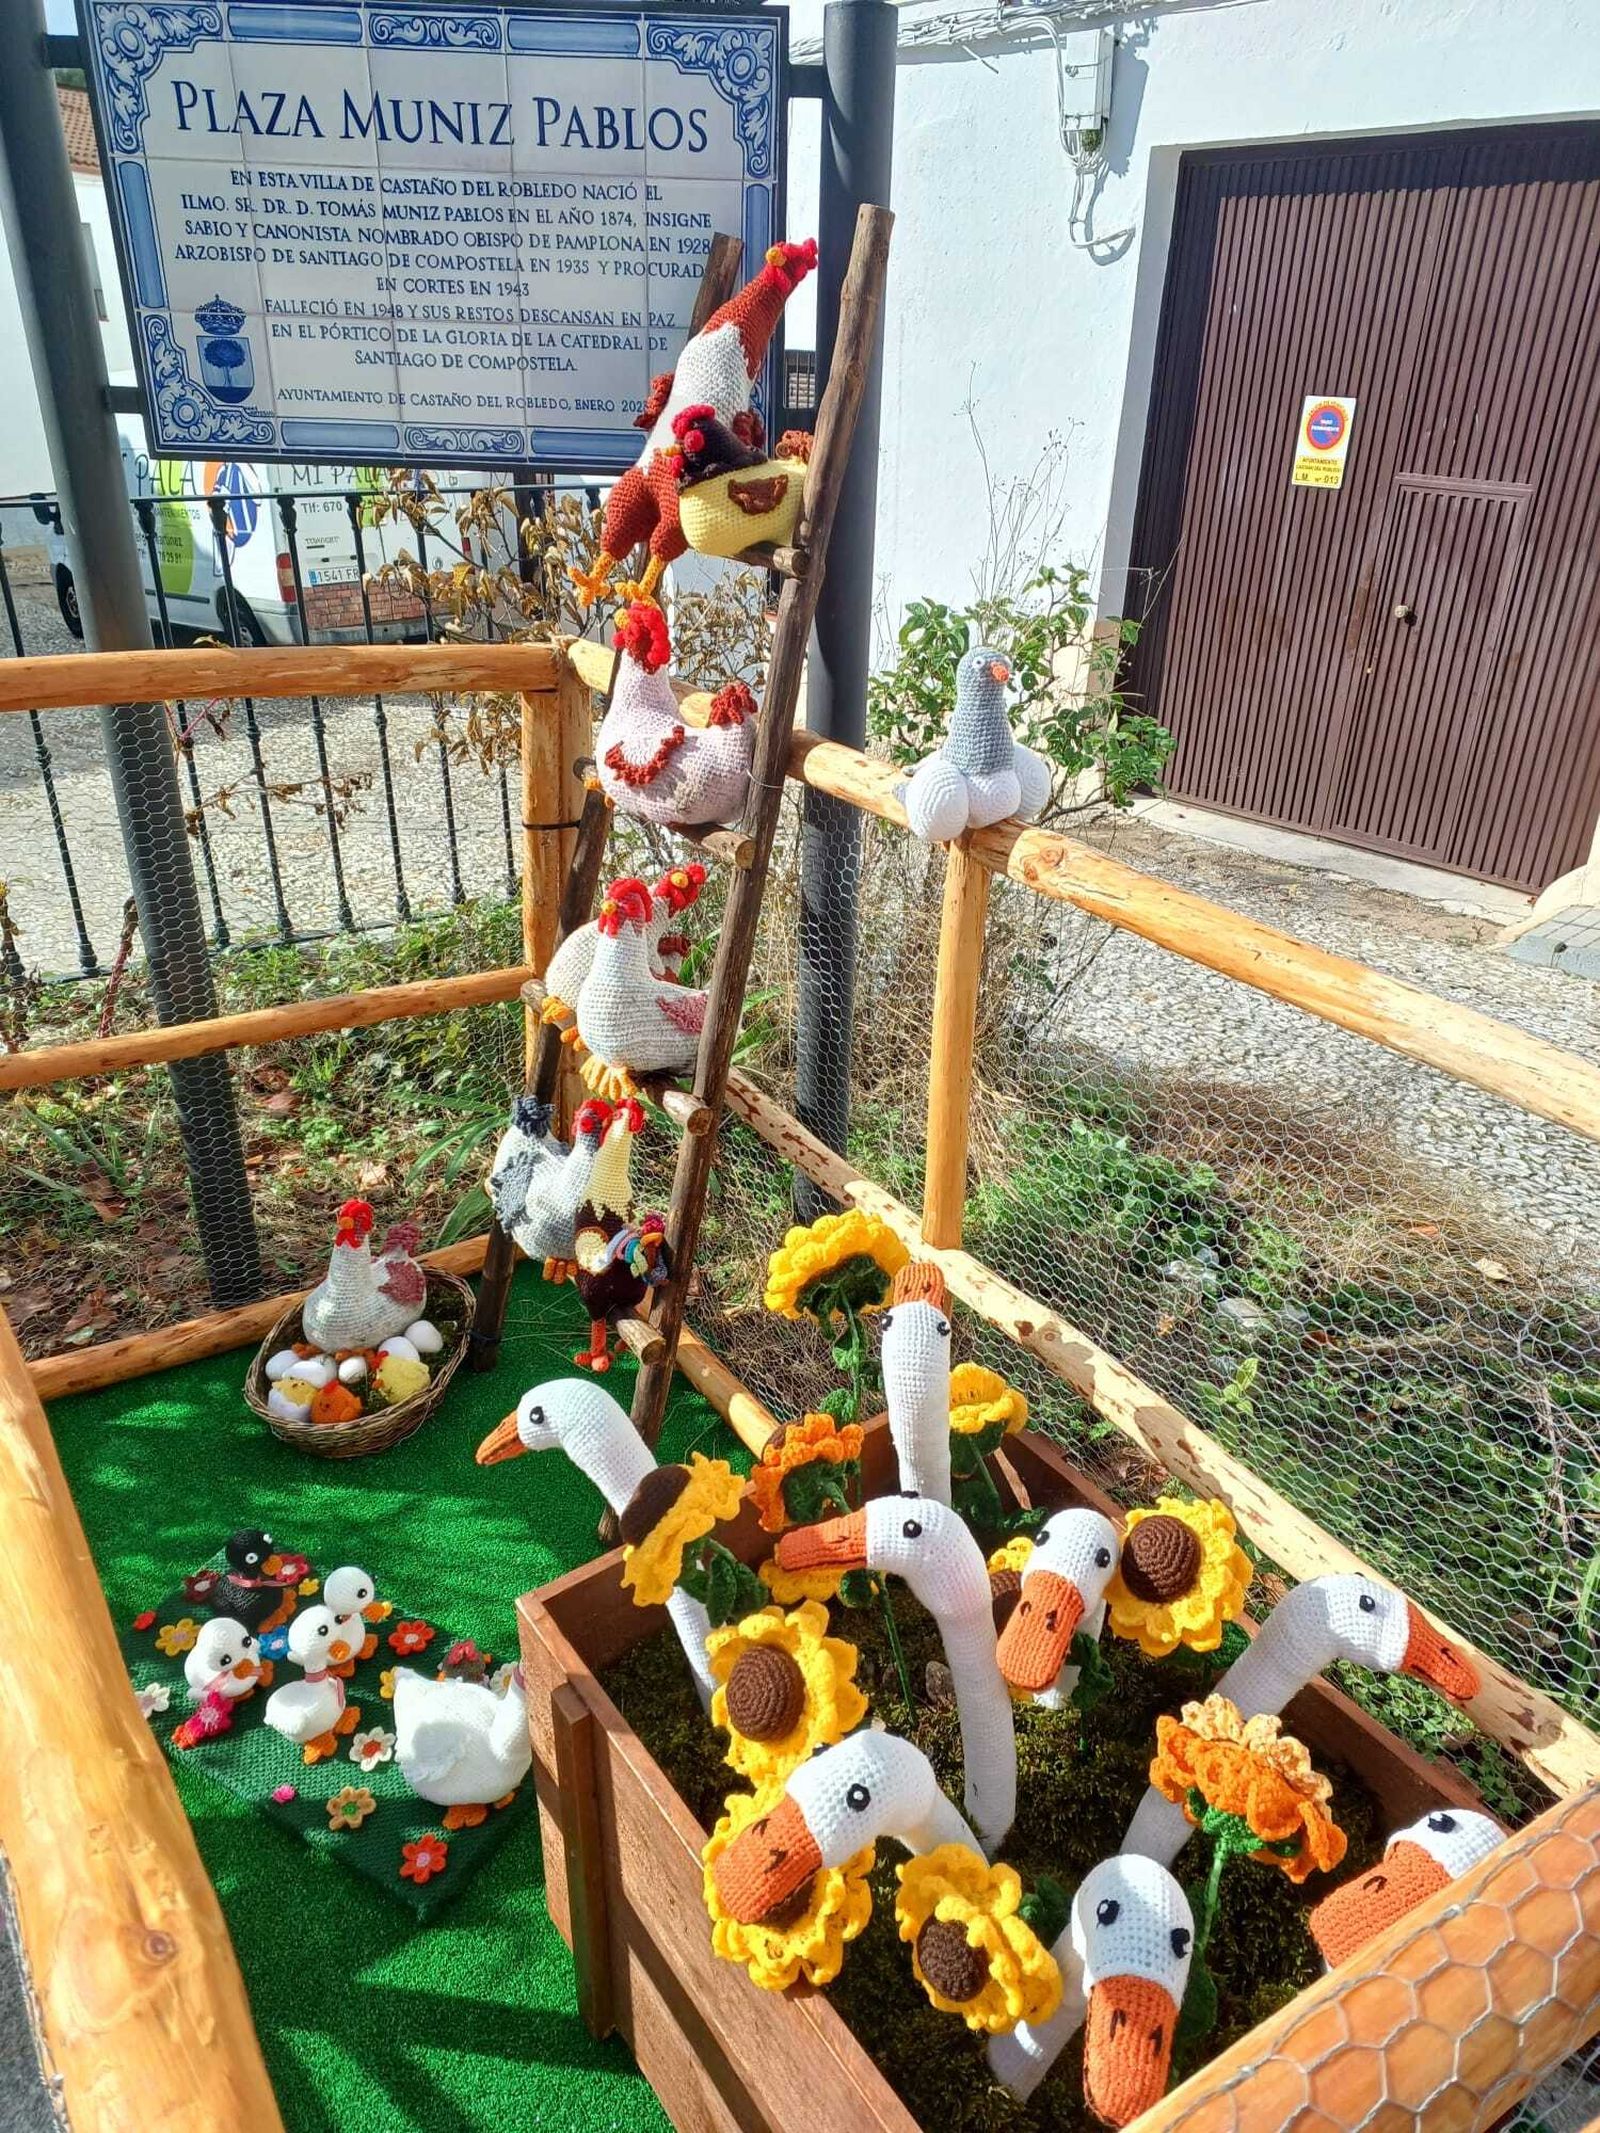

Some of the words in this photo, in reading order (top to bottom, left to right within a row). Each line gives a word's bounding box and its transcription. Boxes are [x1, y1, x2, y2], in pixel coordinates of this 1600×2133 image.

[171, 80, 326, 138] PLAZA
[339, 88, 514, 145] MUNIZ
[532, 96, 708, 152] PABLOS
[231, 170, 252, 186] EN
[258, 171, 299, 188] ESTA
[299, 173, 348, 190] VILLA
[352, 176, 375, 191] DE
[381, 177, 457, 195] CASTAÑO
[462, 180, 494, 196] DEL
[498, 181, 577, 198] ROBLEDO
[583, 181, 637, 200] NACIÓ
[645, 185, 662, 200] EL
[181, 194, 229, 211] ILMO.
[235, 198, 258, 212] SR.
[263, 198, 291, 214] DR.
[296, 200, 313, 215] D.
[316, 199, 376, 218] TOMÁS
[383, 204, 440, 221] MUNIZ
[444, 206, 503, 222] PABLOS
[508, 208, 529, 223] EN
[536, 209, 553, 224] EL
[558, 207, 594, 225] AÑO
[600, 211, 637, 227] 1874,
[645, 211, 712, 228] INSIGNE
[185, 220, 232, 236] SABIO
[235, 222, 248, 237] Y
[254, 223, 352, 242] CANONISTA
[358, 228, 458, 247] NOMBRADO
[464, 231, 523, 248] OBISPO
[529, 233, 550, 249] DE
[556, 234, 645, 251] PAMPLONA
[650, 237, 670, 252] EN
[175, 244, 266, 262] ARZOBISPO
[273, 248, 295, 263] DE
[299, 250, 383, 267] SANTIAGO
[388, 252, 410, 268] DE
[415, 254, 525, 272] COMPOSTELA
[530, 258, 550, 273] EN
[557, 259, 589, 273] 1935
[598, 261, 611, 275] Y
[614, 261, 705, 278] PROCURAD
[376, 277, 397, 291] EN
[403, 278, 465, 295] CORTES
[470, 281, 491, 295] EN
[498, 282, 529, 296] 1943
[264, 298, 338, 315] FALLECIÓ
[344, 301, 365, 316] EN
[372, 303, 403, 318] 1948
[407, 305, 418, 318] Y
[422, 305, 451, 319] SUS
[456, 306, 514, 321] RESTOS
[520, 308, 614, 325] DESCANSAN
[622, 312, 641, 326] EN
[649, 312, 675, 327] PAZ
[271, 323, 292, 337] EN
[299, 325, 316, 338] EL
[320, 322, 392, 341] PÓRTICO
[397, 328, 418, 342] DE
[424, 329, 441, 344] LA
[446, 329, 507, 346] GLORIA
[512, 332, 532, 347] DE
[538, 333, 557, 347] LA
[561, 333, 643, 351] CATEDRAL
[649, 337, 668, 351] DE
[354, 350, 437, 367] SANTIAGO
[442, 353, 463, 368] DE
[468, 354, 578, 371] COMPOSTELA.
[277, 388, 383, 404] AYUNTAMIENTO
[388, 392, 406, 405] DE
[410, 392, 471, 407] CASTAÑO
[477, 394, 501, 408] DEL
[507, 395, 572, 411] ROBLEDO,
[575, 398, 614, 412] ENERO
[301, 502, 320, 514] Tlf:
[322, 501, 343, 513] 670
[318, 568, 345, 583] 1541
[346, 567, 360, 580] FR
